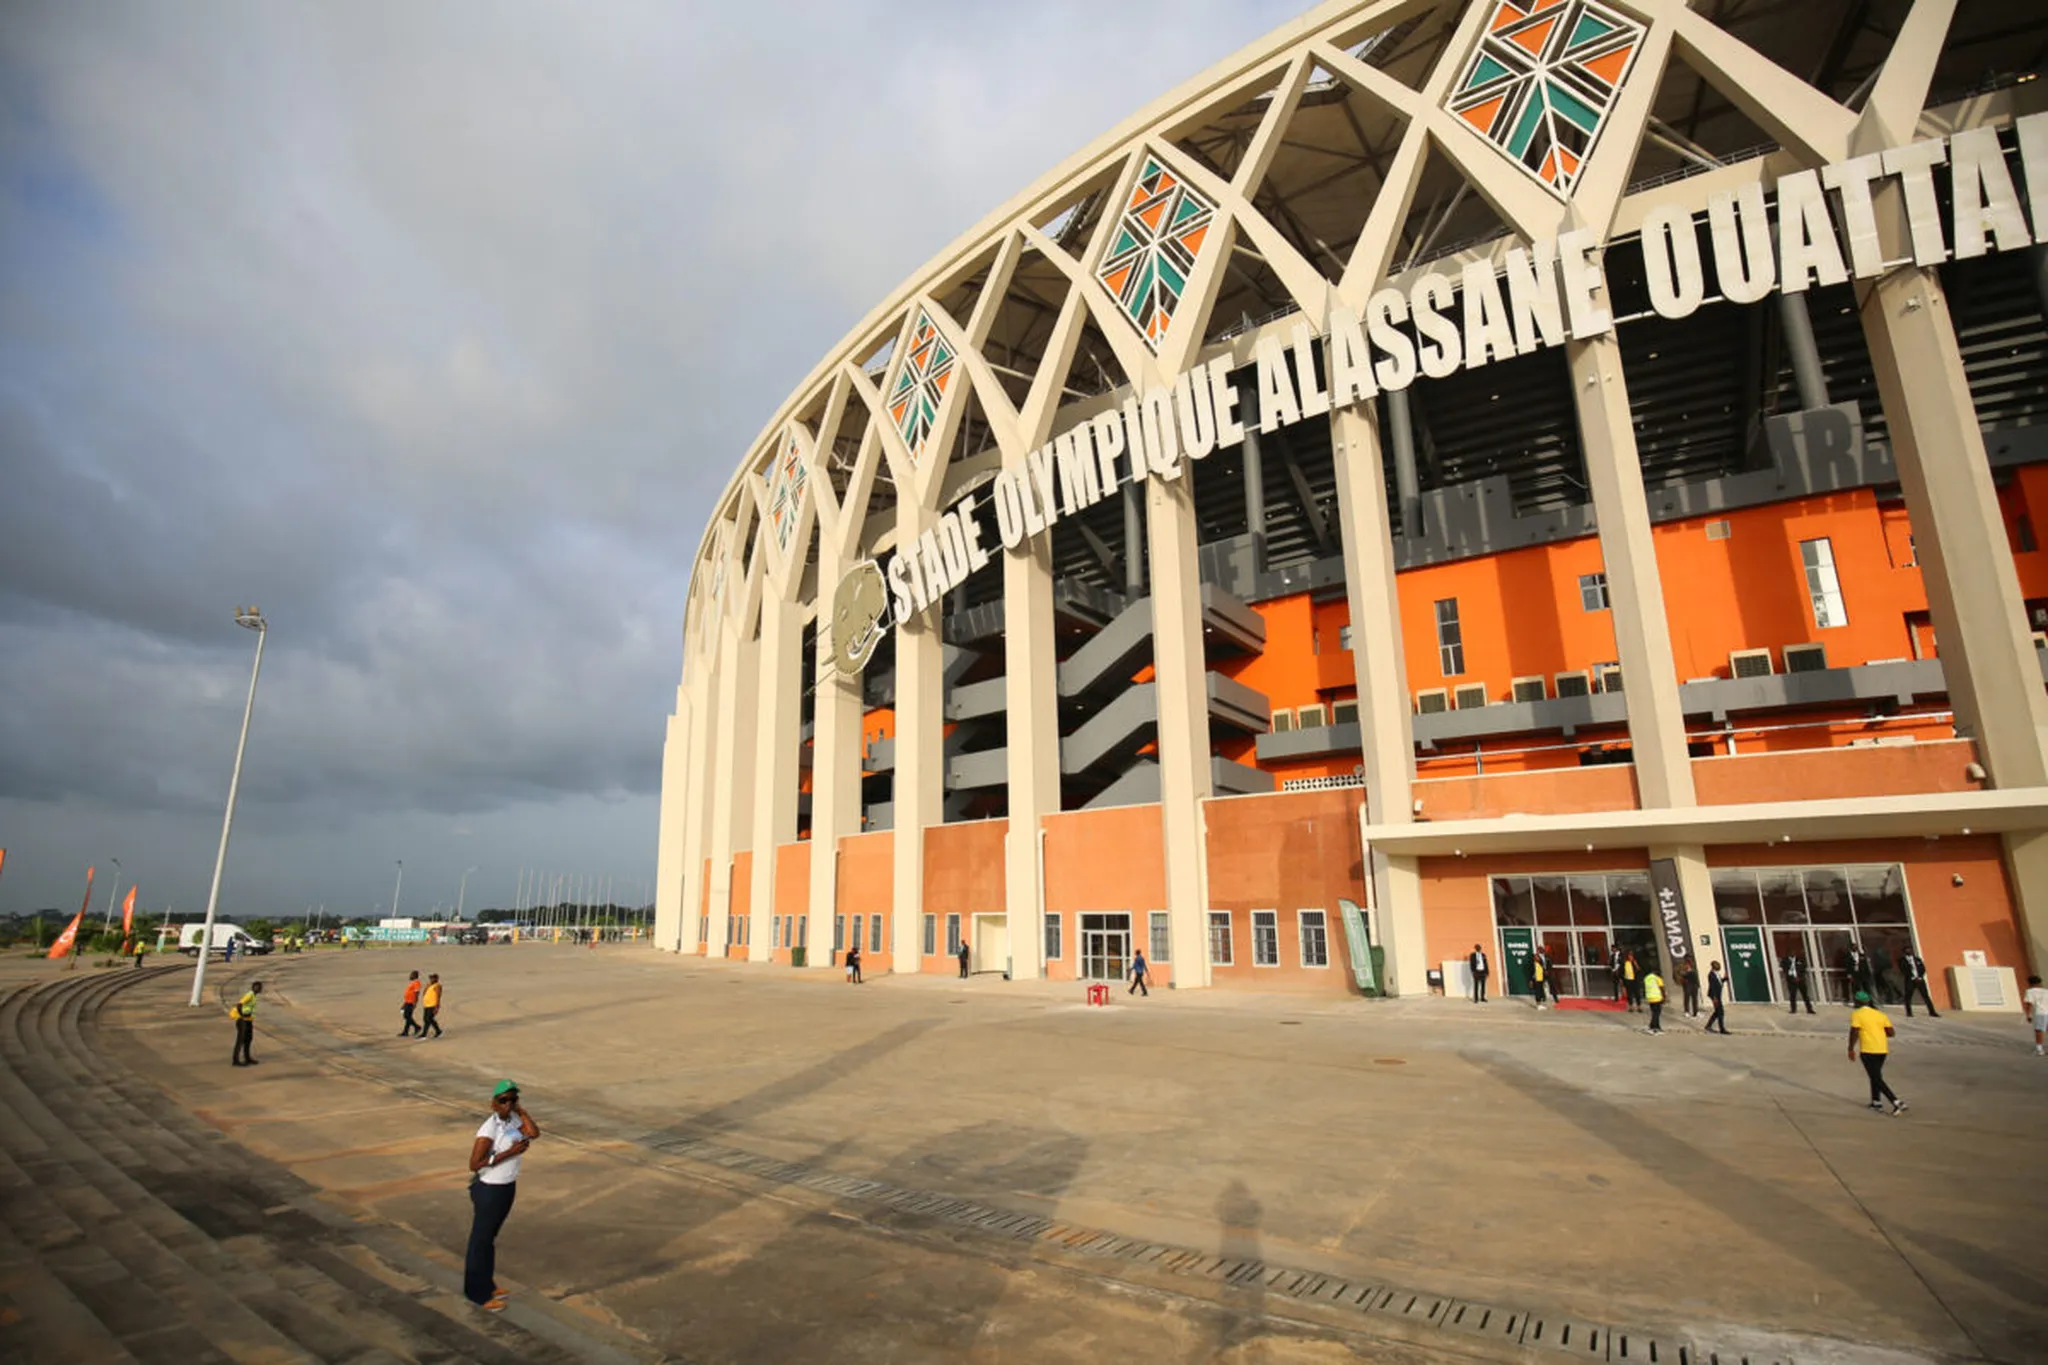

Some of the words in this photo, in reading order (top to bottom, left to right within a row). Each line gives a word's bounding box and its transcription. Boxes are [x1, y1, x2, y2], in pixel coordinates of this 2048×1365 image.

[888, 494, 989, 625] STADE
[993, 352, 1225, 549] OLYMPIQUE
[1256, 227, 1614, 435] ALASSANE
